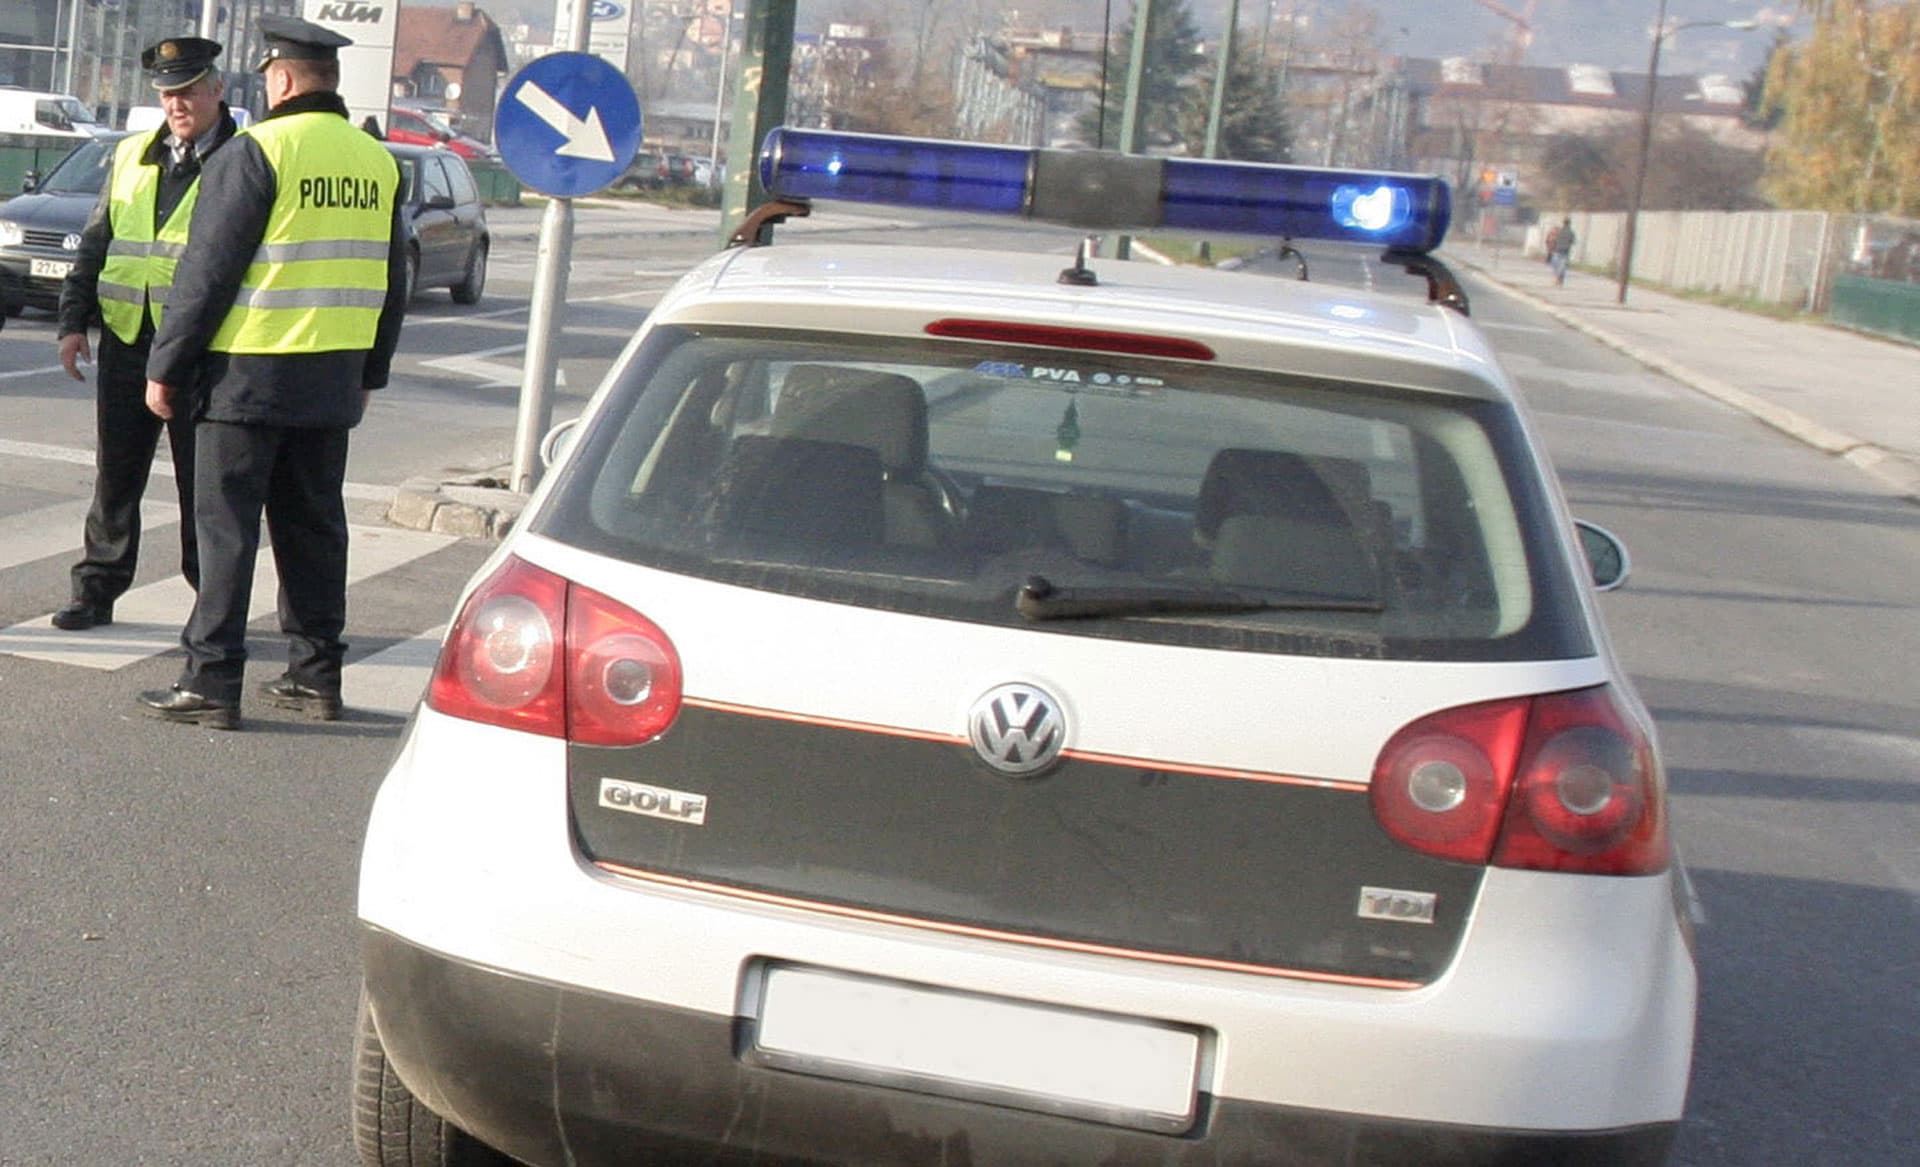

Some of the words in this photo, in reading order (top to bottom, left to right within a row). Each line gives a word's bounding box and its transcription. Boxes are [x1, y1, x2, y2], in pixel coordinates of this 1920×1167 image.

[318, 2, 382, 23] KTM
[300, 176, 379, 211] POLICIJA
[1032, 366, 1080, 382] PVA
[603, 785, 704, 818] GOLF
[1364, 893, 1433, 919] TDI
